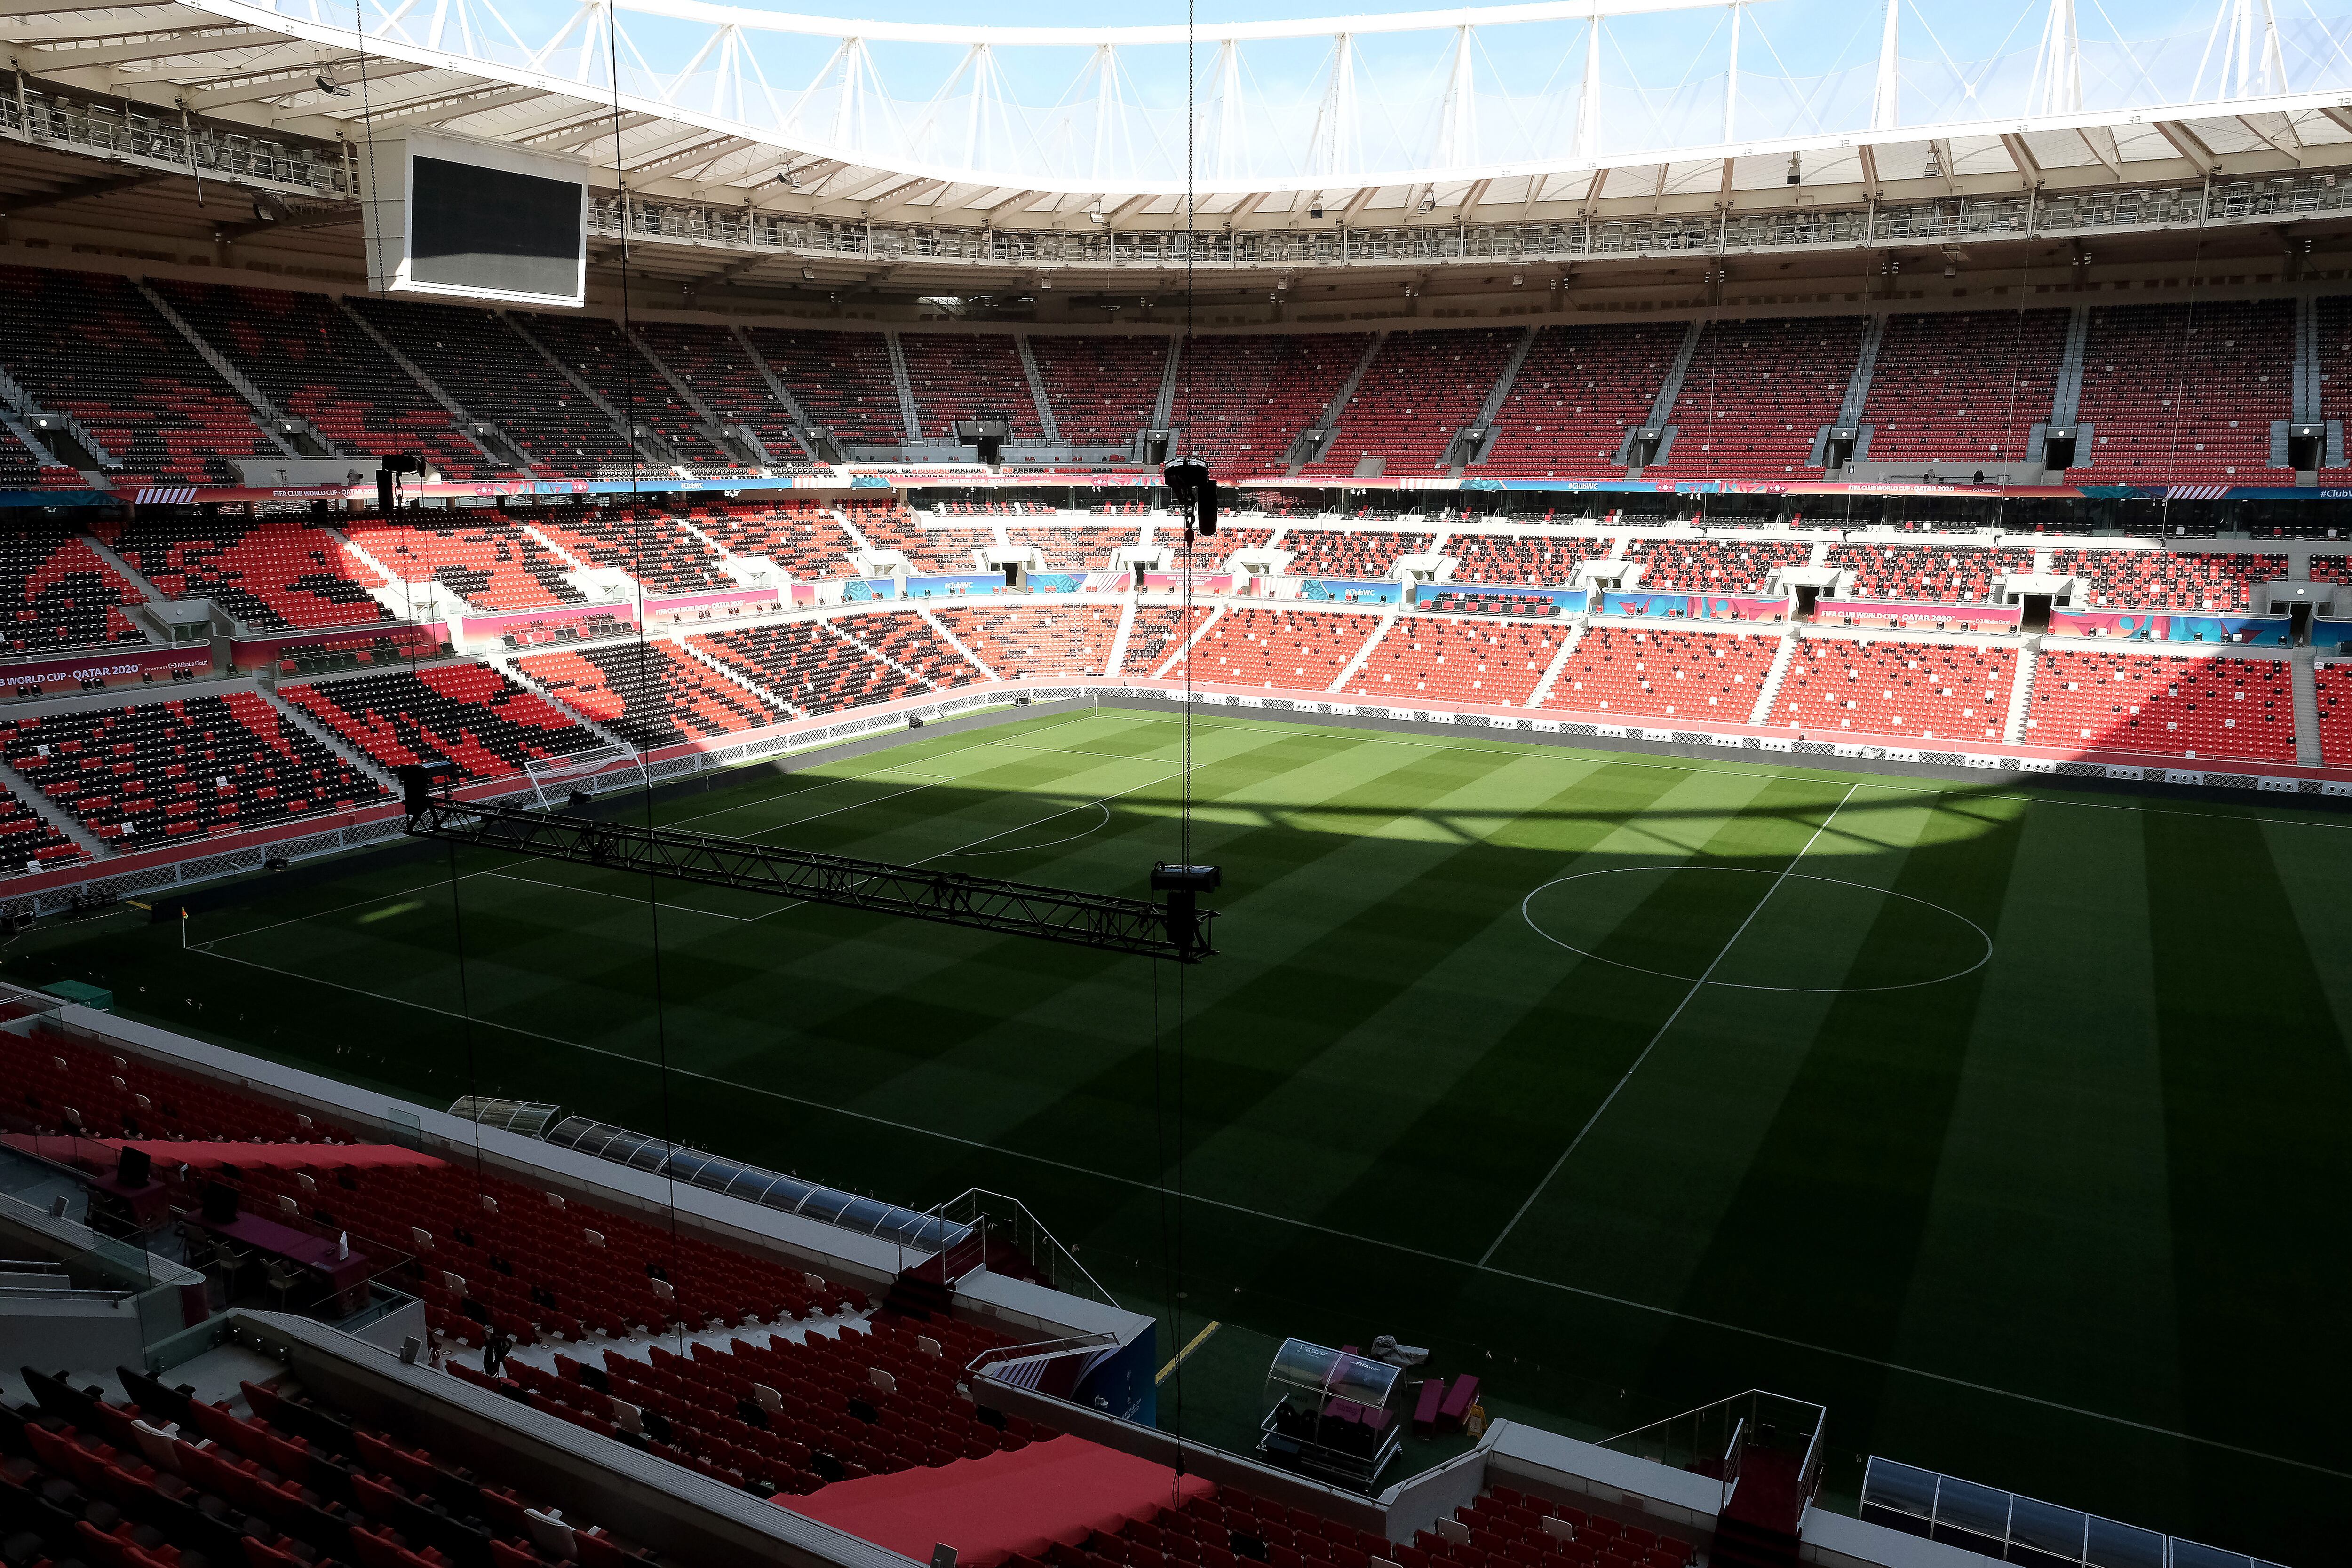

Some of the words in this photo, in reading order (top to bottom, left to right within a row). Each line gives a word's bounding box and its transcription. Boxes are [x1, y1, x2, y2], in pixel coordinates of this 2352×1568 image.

[341, 489, 363, 498] QATAR
[1913, 485, 1936, 494] QATAR
[1901, 613, 1931, 624] QATAR
[7, 674, 45, 685] WORLD
[47, 673, 66, 681] CUP
[73, 667, 111, 681] QATAR
[112, 664, 139, 675] 2020
